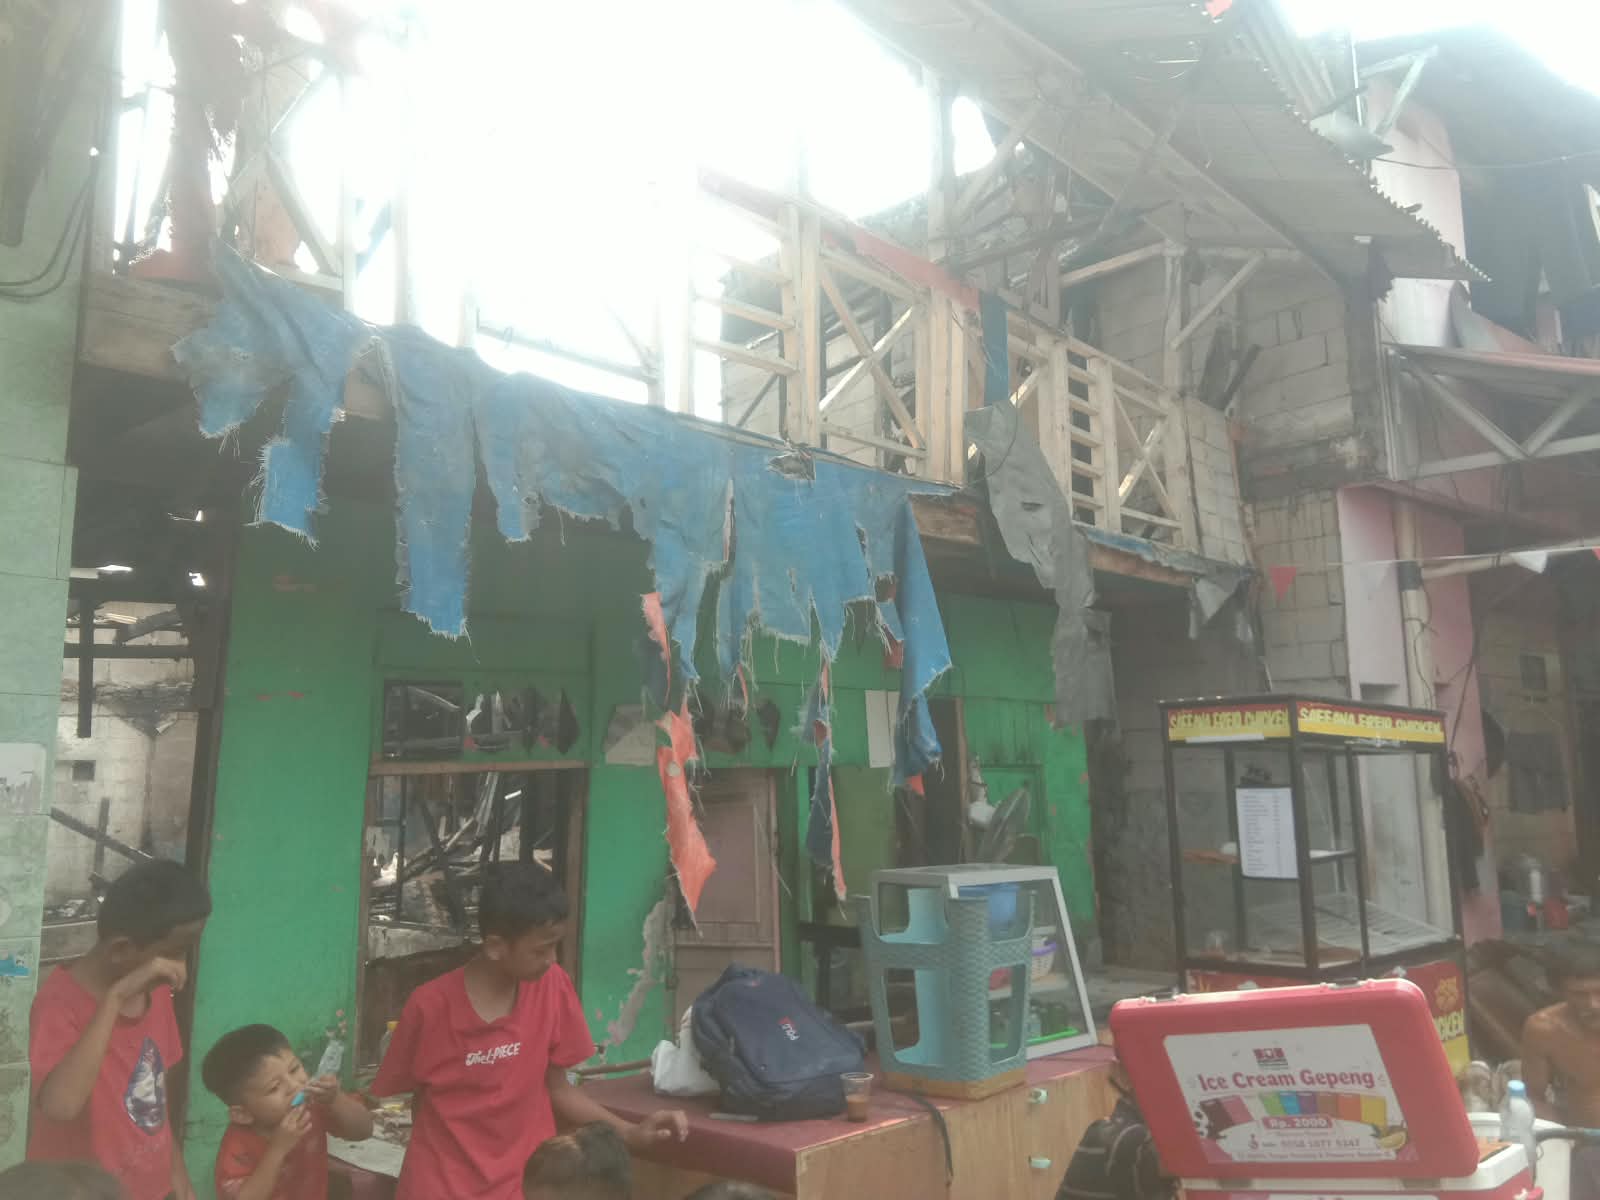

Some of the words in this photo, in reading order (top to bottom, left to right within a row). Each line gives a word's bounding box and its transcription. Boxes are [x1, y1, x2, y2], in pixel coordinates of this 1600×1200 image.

[1198, 1074, 1229, 1091] Ice
[1232, 1070, 1296, 1089] Cream
[1300, 1068, 1375, 1089] Gepeng
